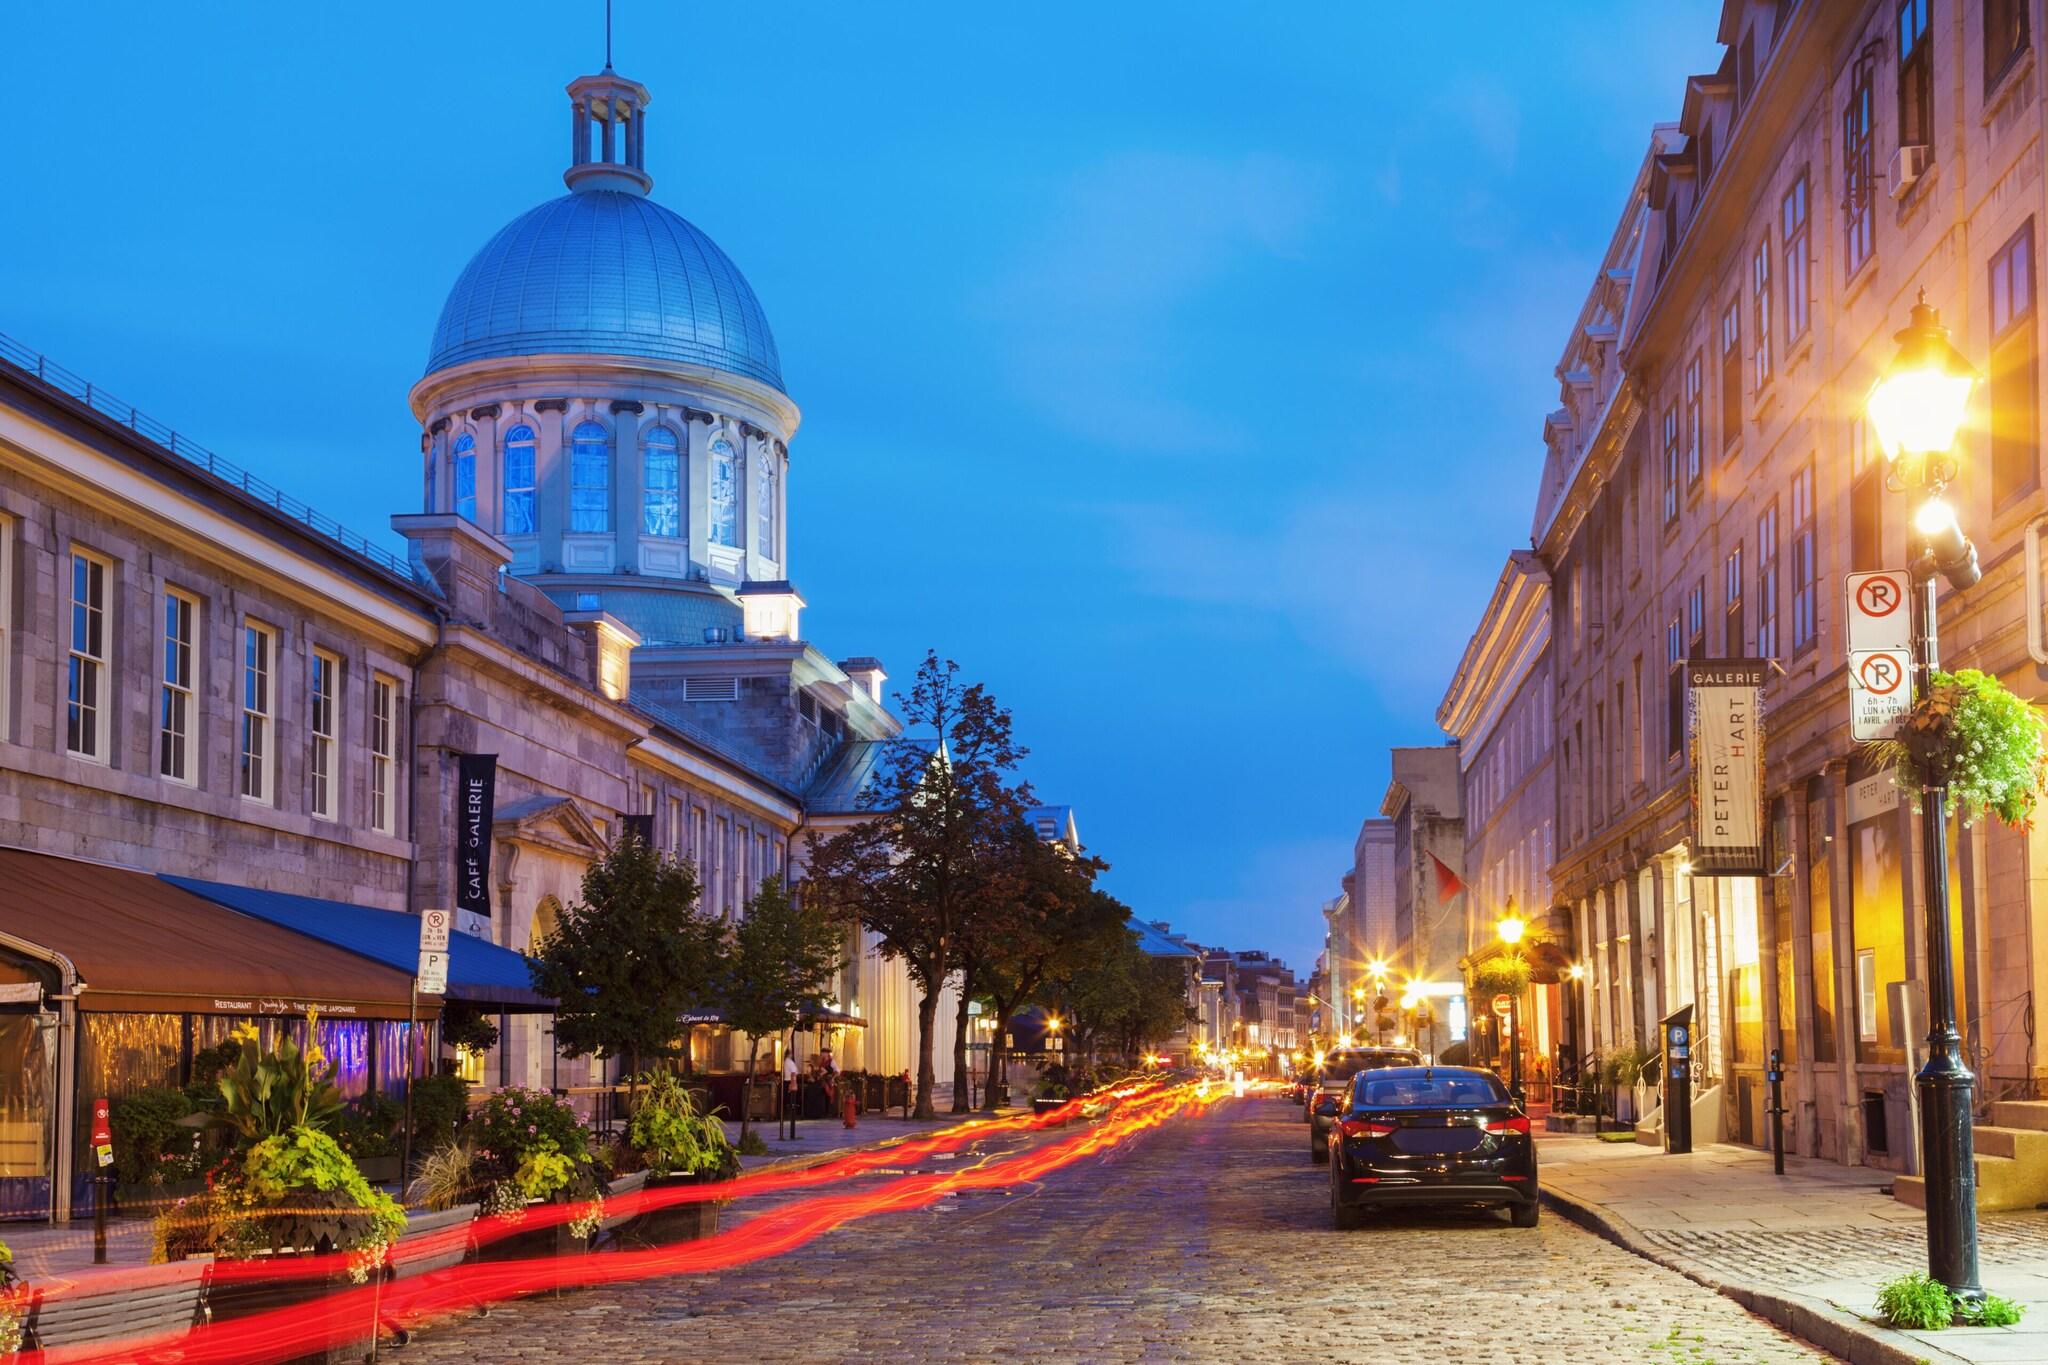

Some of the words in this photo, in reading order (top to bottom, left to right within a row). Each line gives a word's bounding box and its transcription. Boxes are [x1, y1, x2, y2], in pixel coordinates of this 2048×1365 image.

[1693, 673, 1761, 684] GALERIE
[1867, 696, 1878, 705] 6h
[1888, 696, 1898, 705] 7h
[1863, 705, 1878, 715] LUN
[1887, 705, 1903, 715] VEN
[1863, 715, 1880, 724] AVRIL
[1730, 698, 1745, 758] HART
[468, 778, 483, 848] GALERIE
[466, 856, 481, 899] CAFÉ
[429, 955, 438, 967] P
[214, 999, 252, 1009] RESTAURANT
